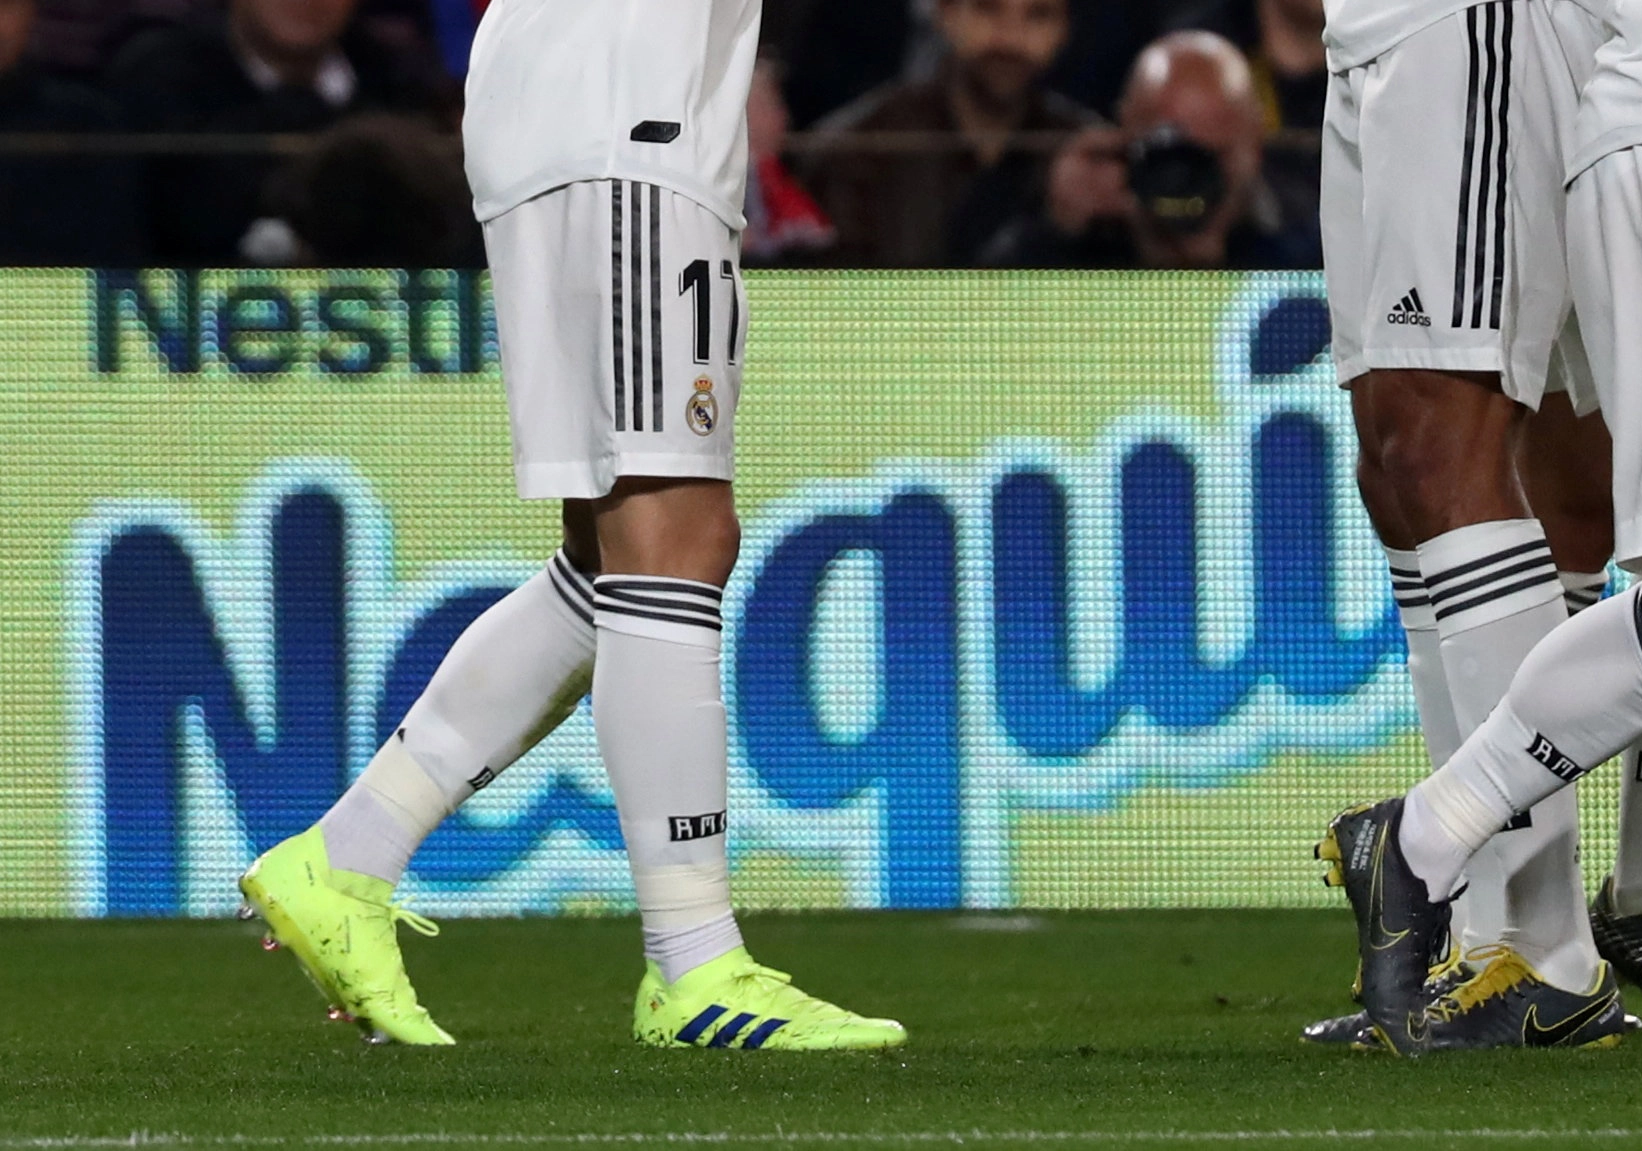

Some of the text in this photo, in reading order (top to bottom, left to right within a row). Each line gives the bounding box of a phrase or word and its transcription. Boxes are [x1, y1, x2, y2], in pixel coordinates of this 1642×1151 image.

[97, 269, 490, 374] Nestl
[678, 258, 739, 366] 17
[1387, 310, 1432, 327] adidas
